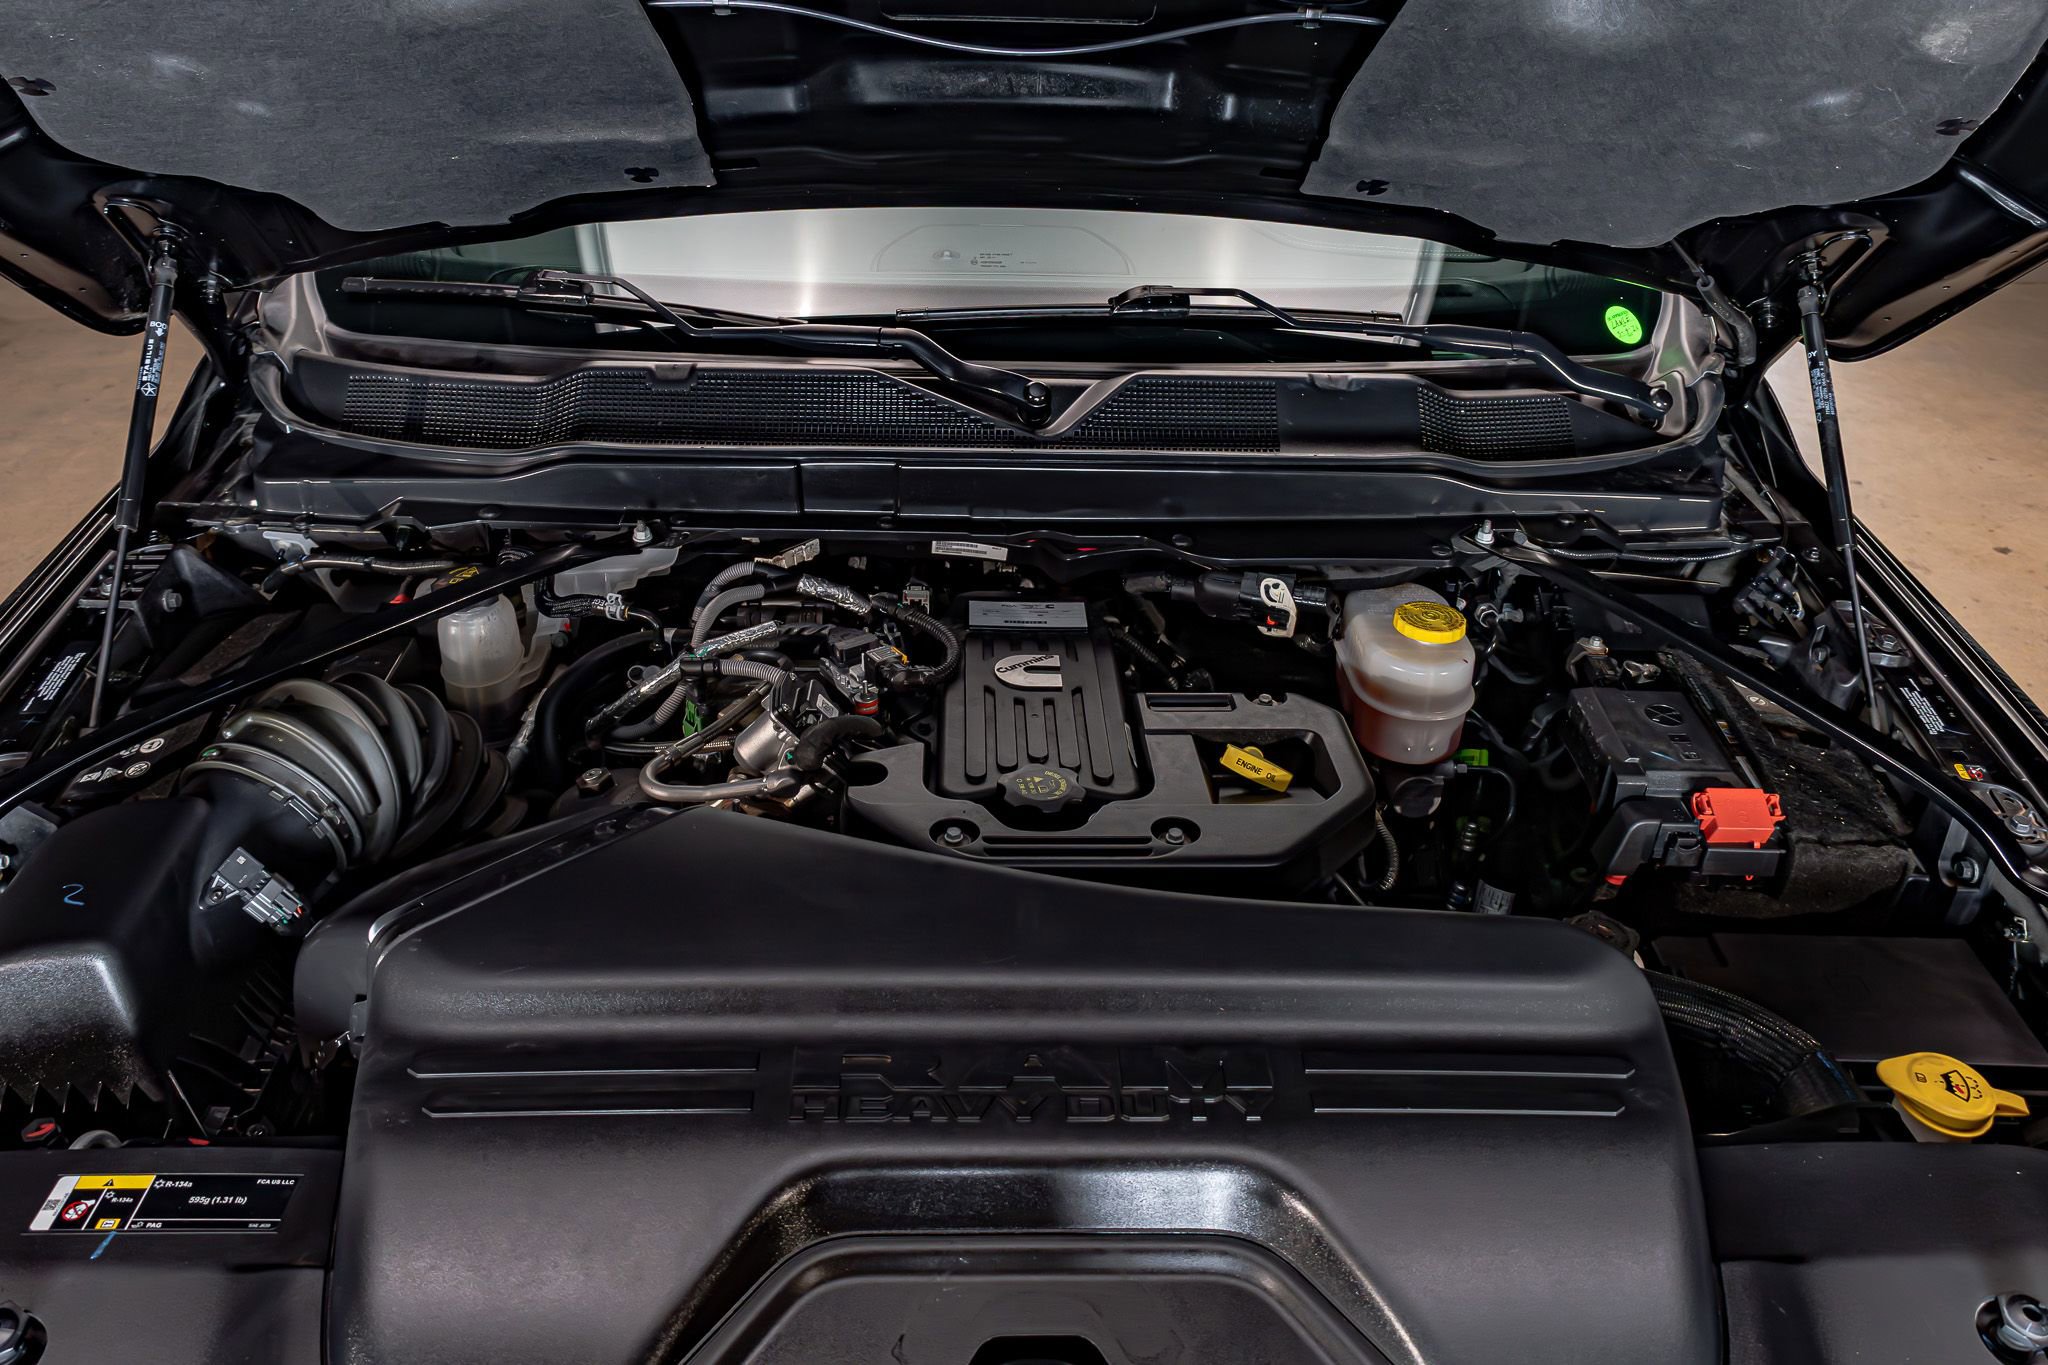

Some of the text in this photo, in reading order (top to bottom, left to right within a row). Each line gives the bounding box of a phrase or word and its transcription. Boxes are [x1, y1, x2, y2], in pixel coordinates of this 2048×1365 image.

[142, 338, 154, 381] STABILUS
[996, 653, 1055, 673] Cummins
[1235, 758, 1277, 782] ENGINE OIL
[62, 883, 85, 906] 2
[791, 1046, 1274, 1091] RAM
[788, 1094, 1274, 1122] HEAVY DUTY
[188, 1196, 247, 1205] 595g (1.31 lb)
